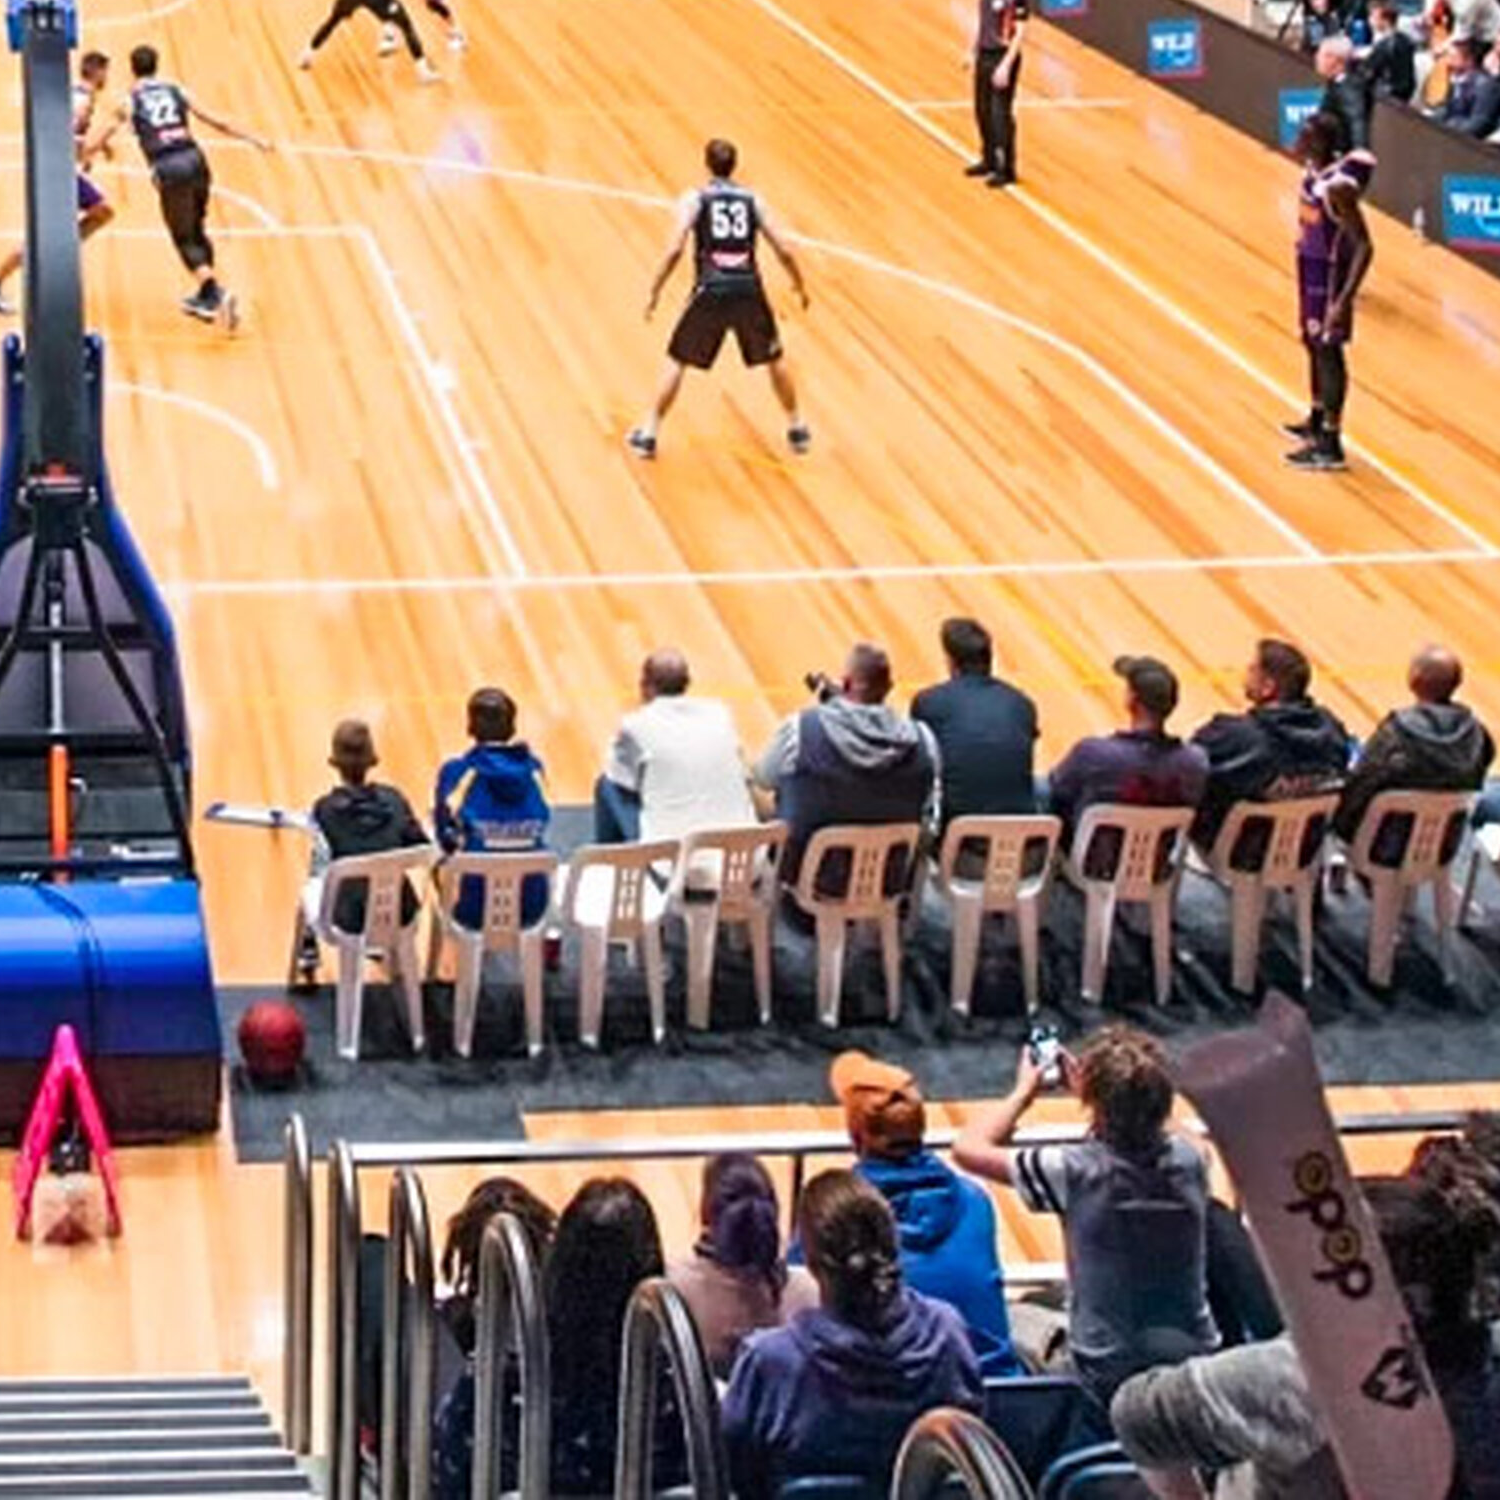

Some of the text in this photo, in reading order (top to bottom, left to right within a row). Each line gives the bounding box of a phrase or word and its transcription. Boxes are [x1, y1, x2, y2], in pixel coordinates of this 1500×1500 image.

[1151, 32, 1195, 51] WILD
[1450, 191, 1500, 217] WIL
[711, 199, 749, 239] 53
